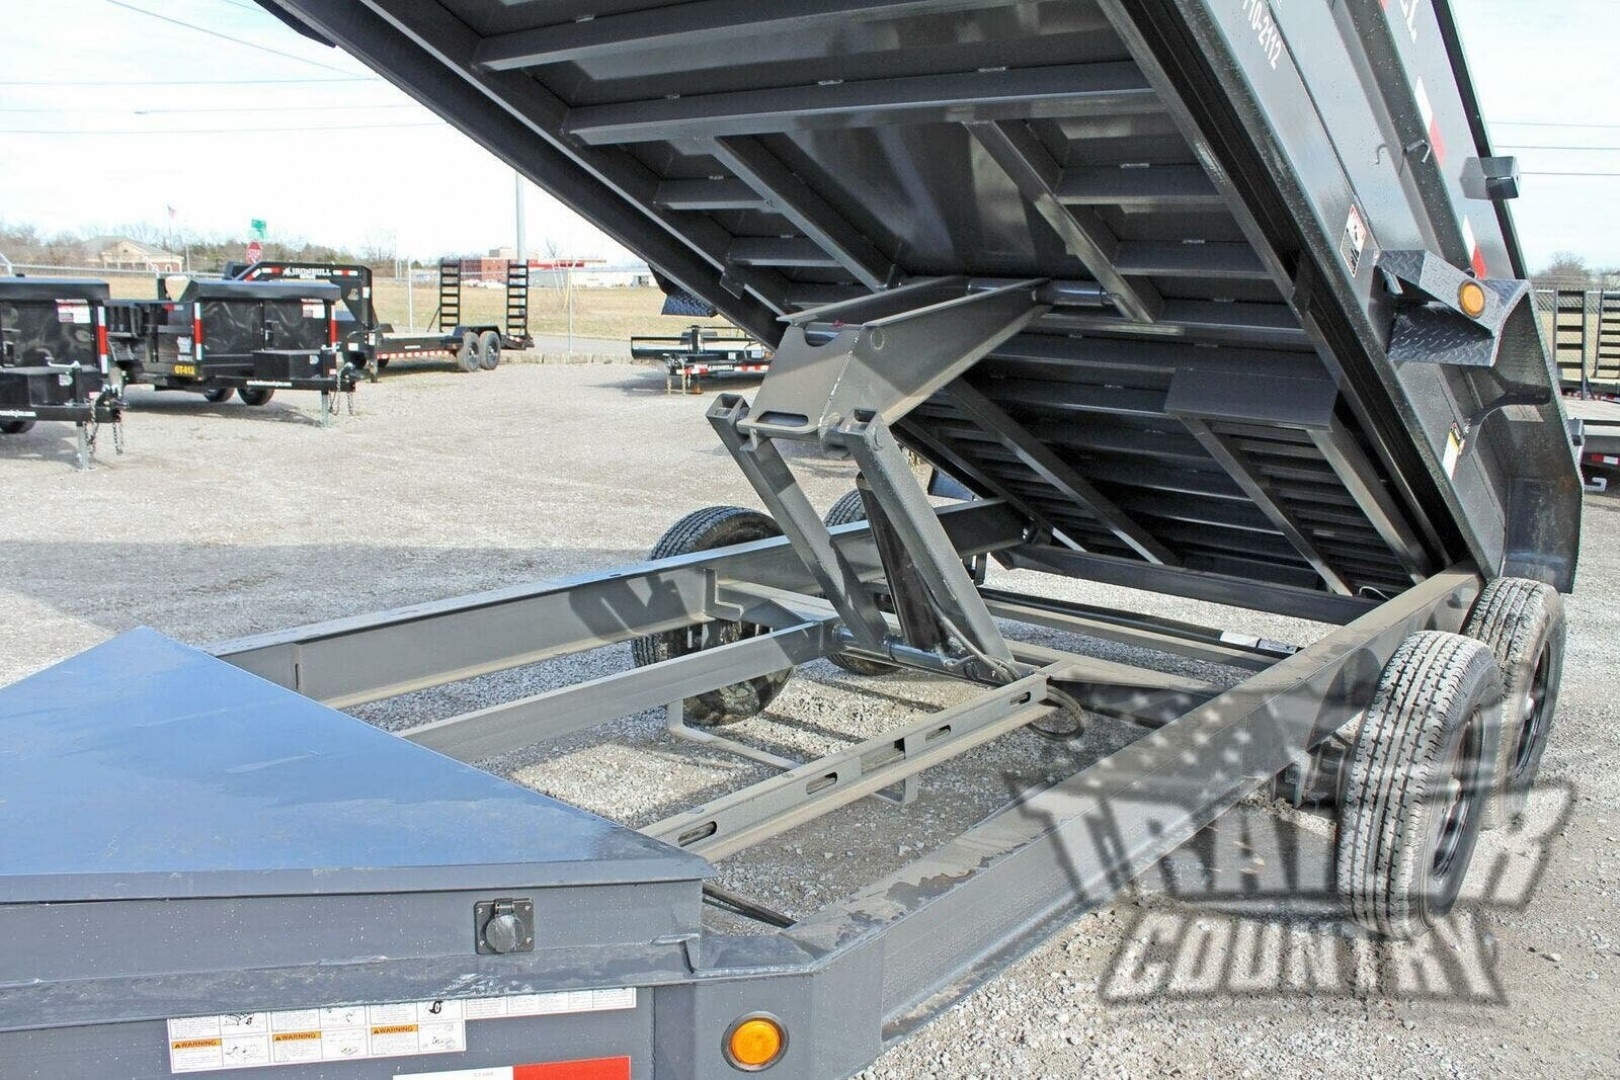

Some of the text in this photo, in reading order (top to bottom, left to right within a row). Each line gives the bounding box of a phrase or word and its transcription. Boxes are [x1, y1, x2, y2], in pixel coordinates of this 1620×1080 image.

[379, 1024, 414, 1034] WARNING
[280, 1032, 317, 1041] WARNING
[179, 1039, 218, 1049] WARNING
